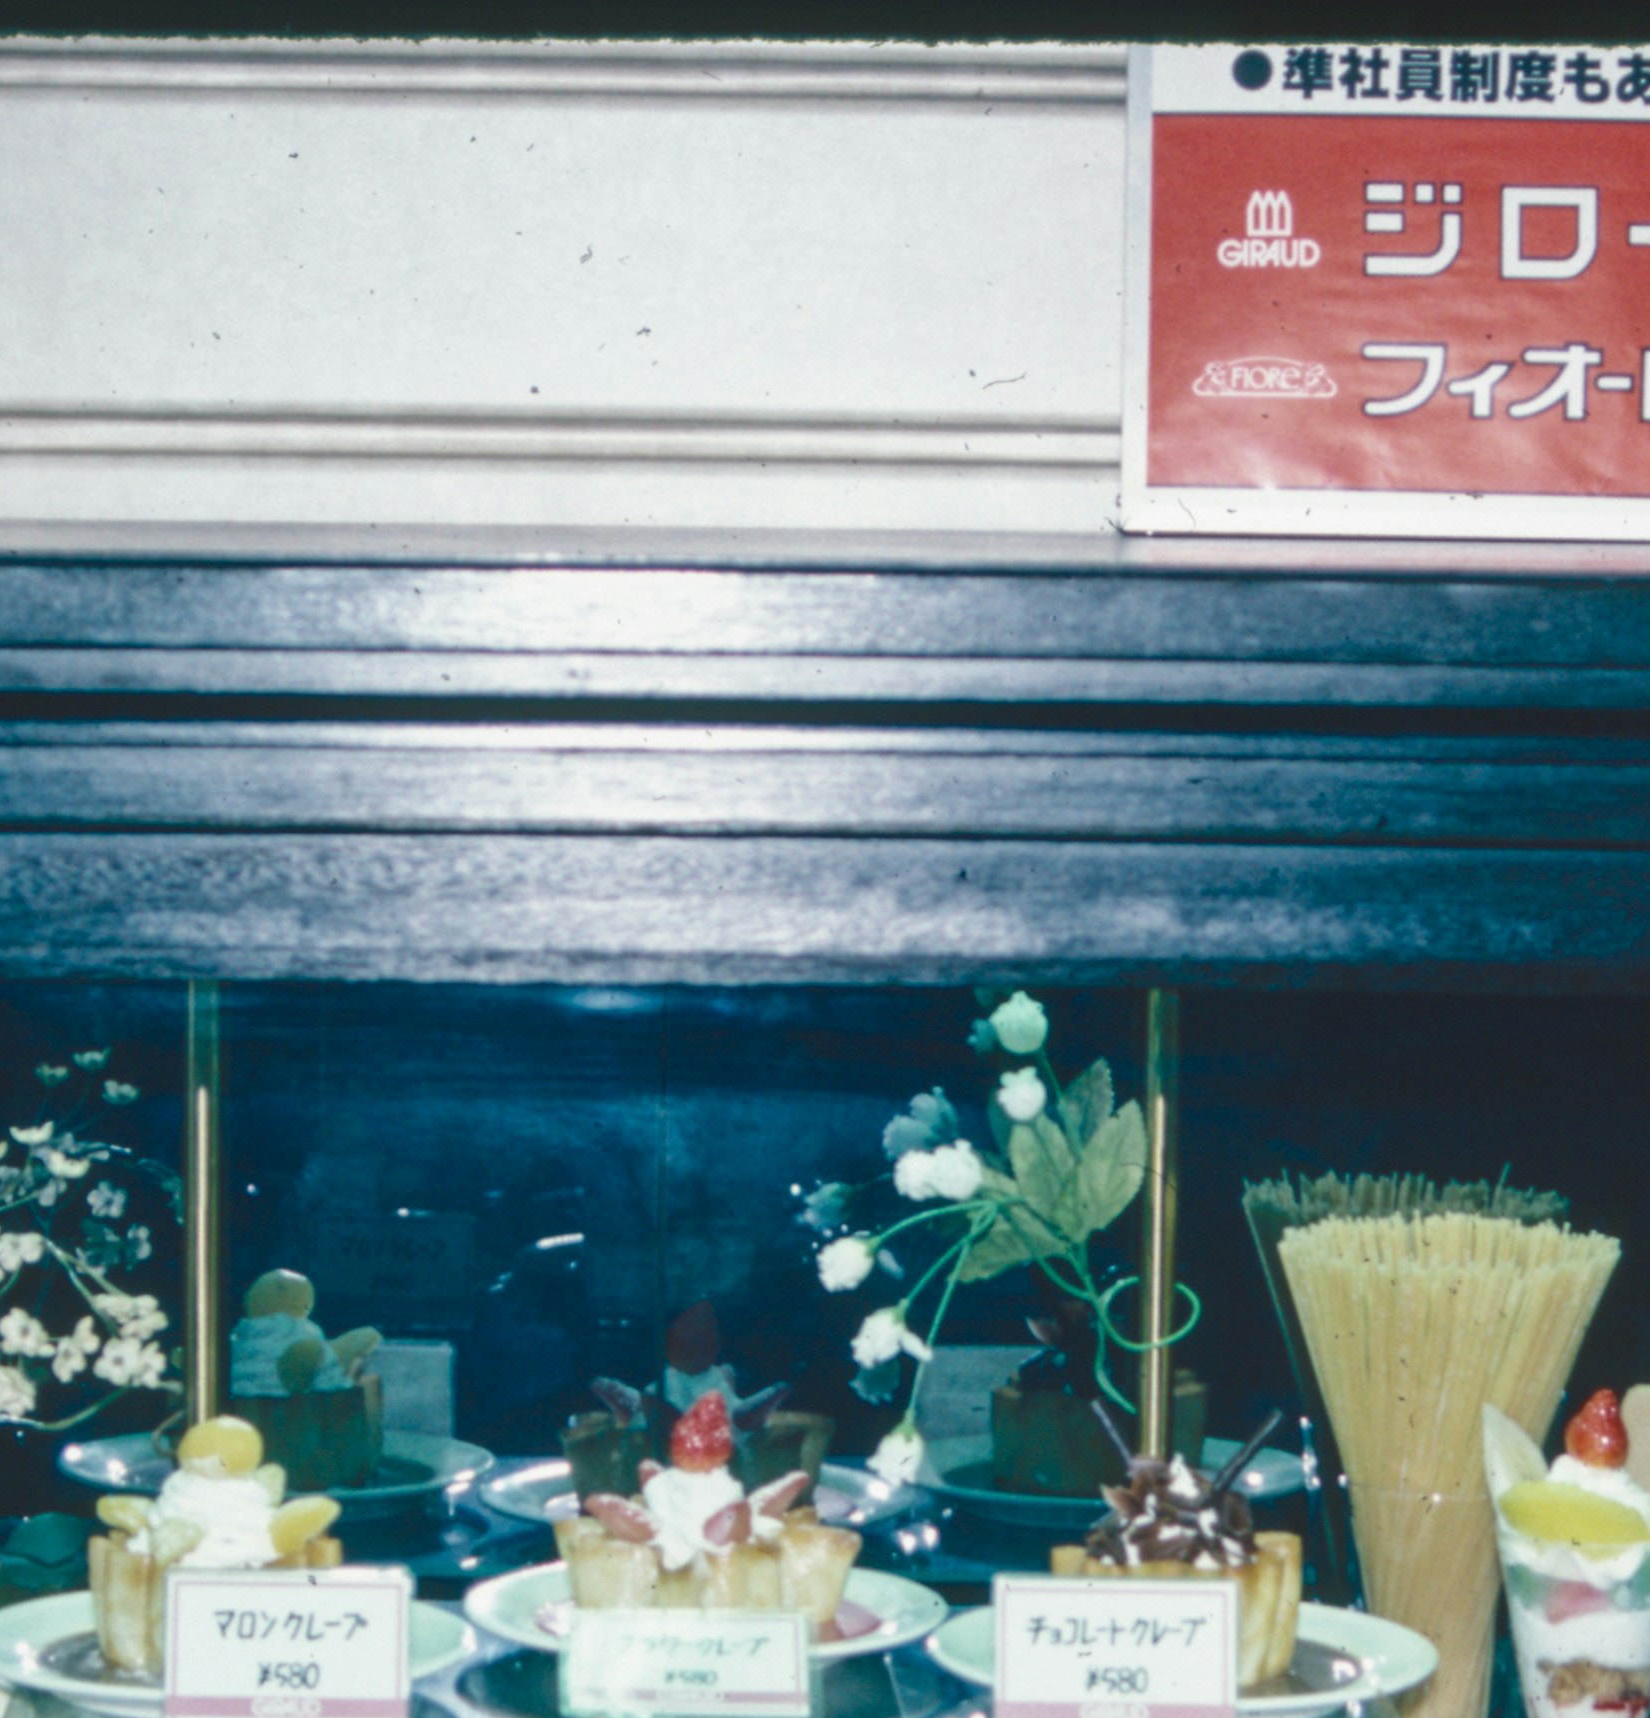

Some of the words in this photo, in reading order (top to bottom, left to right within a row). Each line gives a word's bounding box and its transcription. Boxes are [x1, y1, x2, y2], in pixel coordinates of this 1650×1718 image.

[1216, 238, 1322, 269] GIRAUD
[214, 1609, 368, 1641] マロンクレープ
[257, 1661, 321, 1690] ¥580
[1085, 1667, 1150, 1695] ¥580
